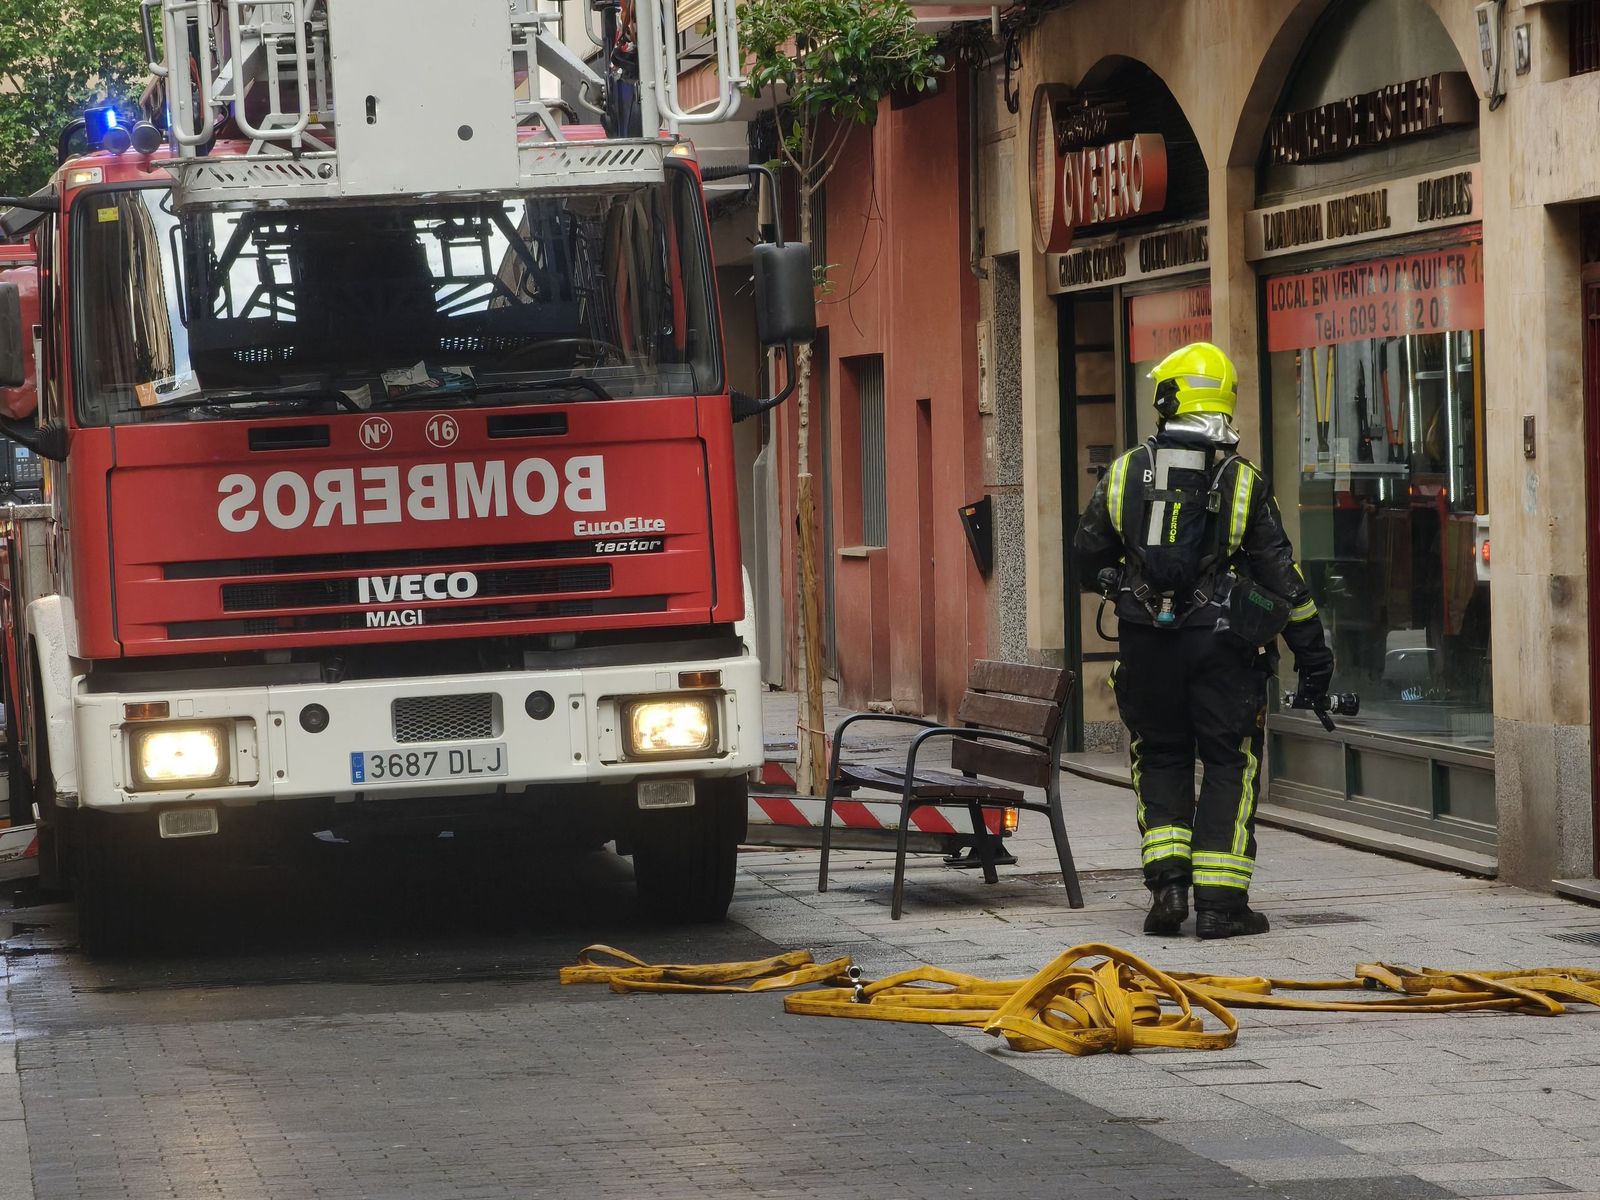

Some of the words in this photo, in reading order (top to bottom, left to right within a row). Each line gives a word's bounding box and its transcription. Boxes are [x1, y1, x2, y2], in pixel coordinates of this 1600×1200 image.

[1063, 133, 1144, 227] OVEJERO
[1271, 277, 1308, 312] LOCAL
[1312, 275, 1329, 305] EN
[1332, 263, 1376, 300] VENTA
[1379, 263, 1390, 293] O
[1394, 253, 1467, 293] ALQUILER
[1350, 303, 1377, 336] 609
[1382, 305, 1399, 332] 31
[429, 421, 455, 441] 16
[573, 517, 666, 537] EuroFire
[594, 538, 662, 553] tector
[358, 571, 478, 604] IVECO
[366, 609, 423, 628] MAGI
[370, 751, 438, 779] 3687
[449, 747, 501, 775] DLJ
